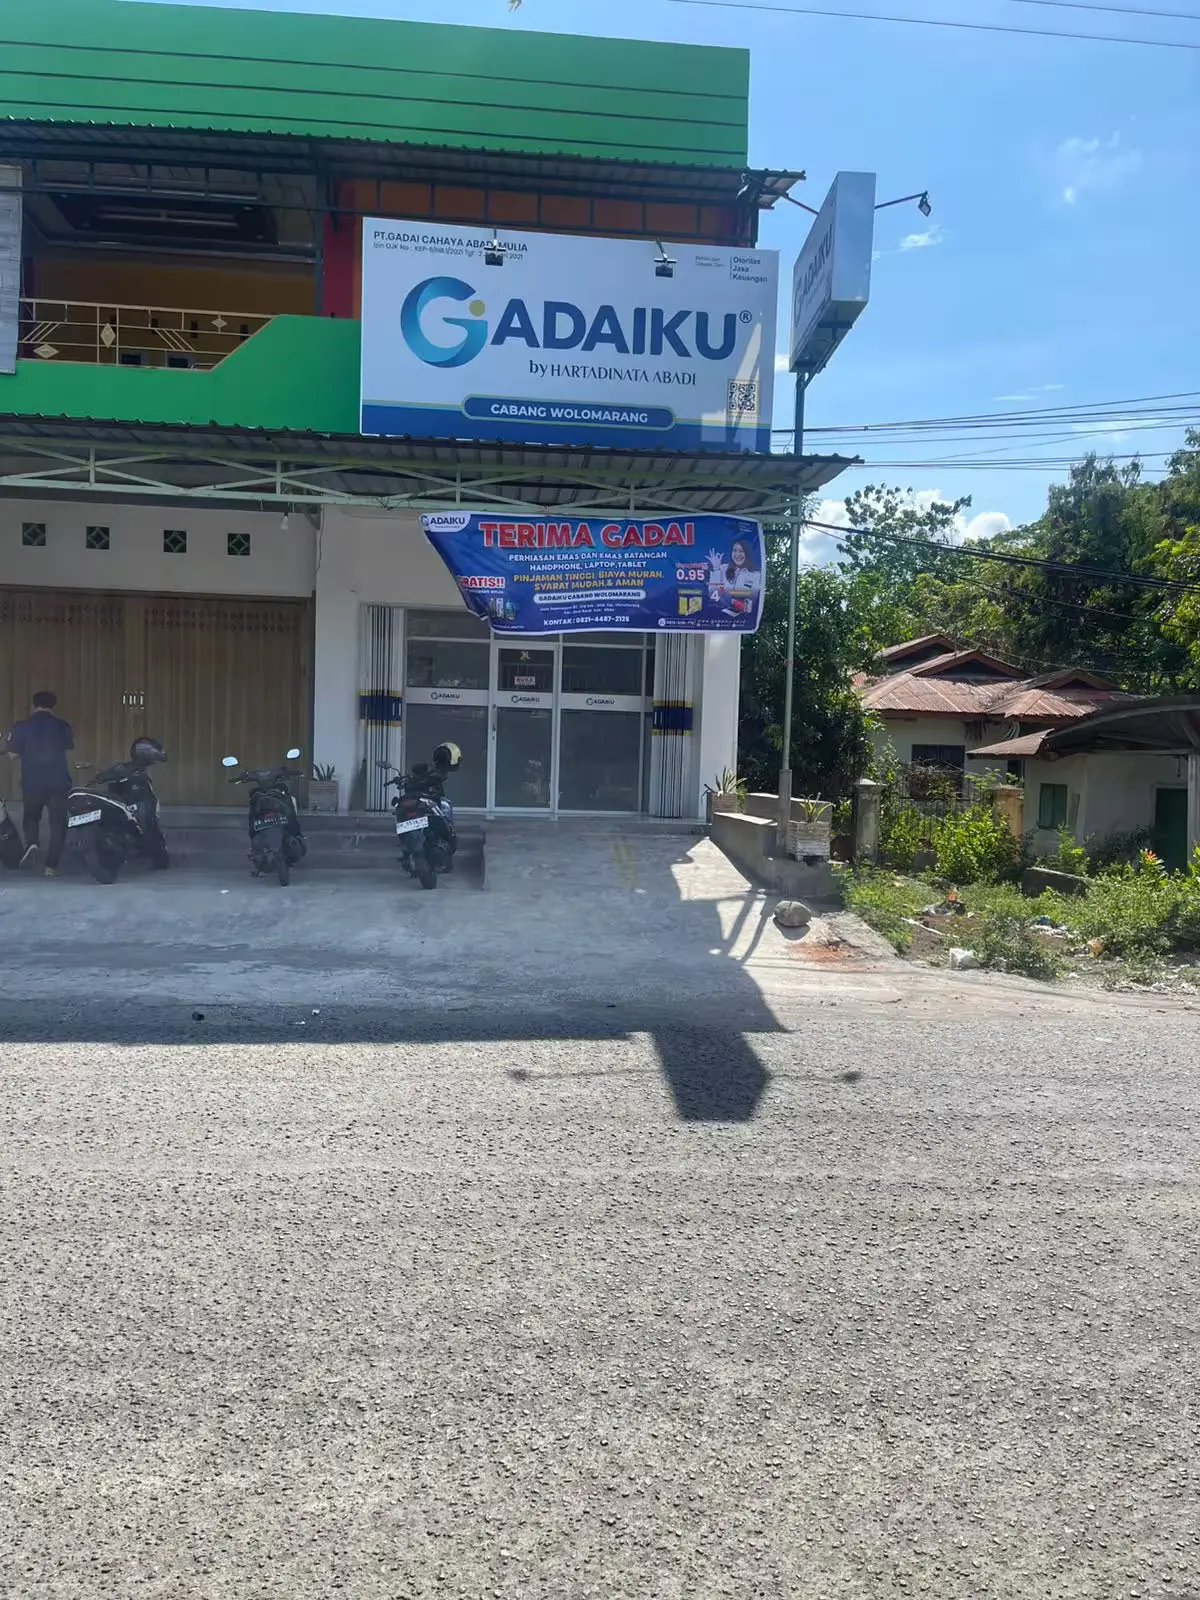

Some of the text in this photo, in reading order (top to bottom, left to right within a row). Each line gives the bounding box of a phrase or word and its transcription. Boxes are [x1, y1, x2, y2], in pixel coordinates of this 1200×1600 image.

[421, 235, 464, 247] CAHAYA
[466, 239, 497, 250] ABAD
[498, 241, 528, 252] MULIA
[733, 265, 749, 273] Jasa
[733, 273, 768, 284] Keuangan
[529, 360, 697, 386] by HARTADINATA ABADI
[490, 403, 649, 424] CABANG WOLOMARANG
[479, 522, 695, 549] TERIMA GADAI
[509, 551, 668, 562] PERHIASAN EMAS DAN EMAS BATANGAN
[513, 573, 563, 583] PINJAMAN
[598, 571, 626, 580] BIAYA
[676, 569, 705, 581] 0.95
[458, 575, 506, 589] RATIS!!
[534, 582, 569, 591] SYARAT
[615, 579, 644, 587] AMAN
